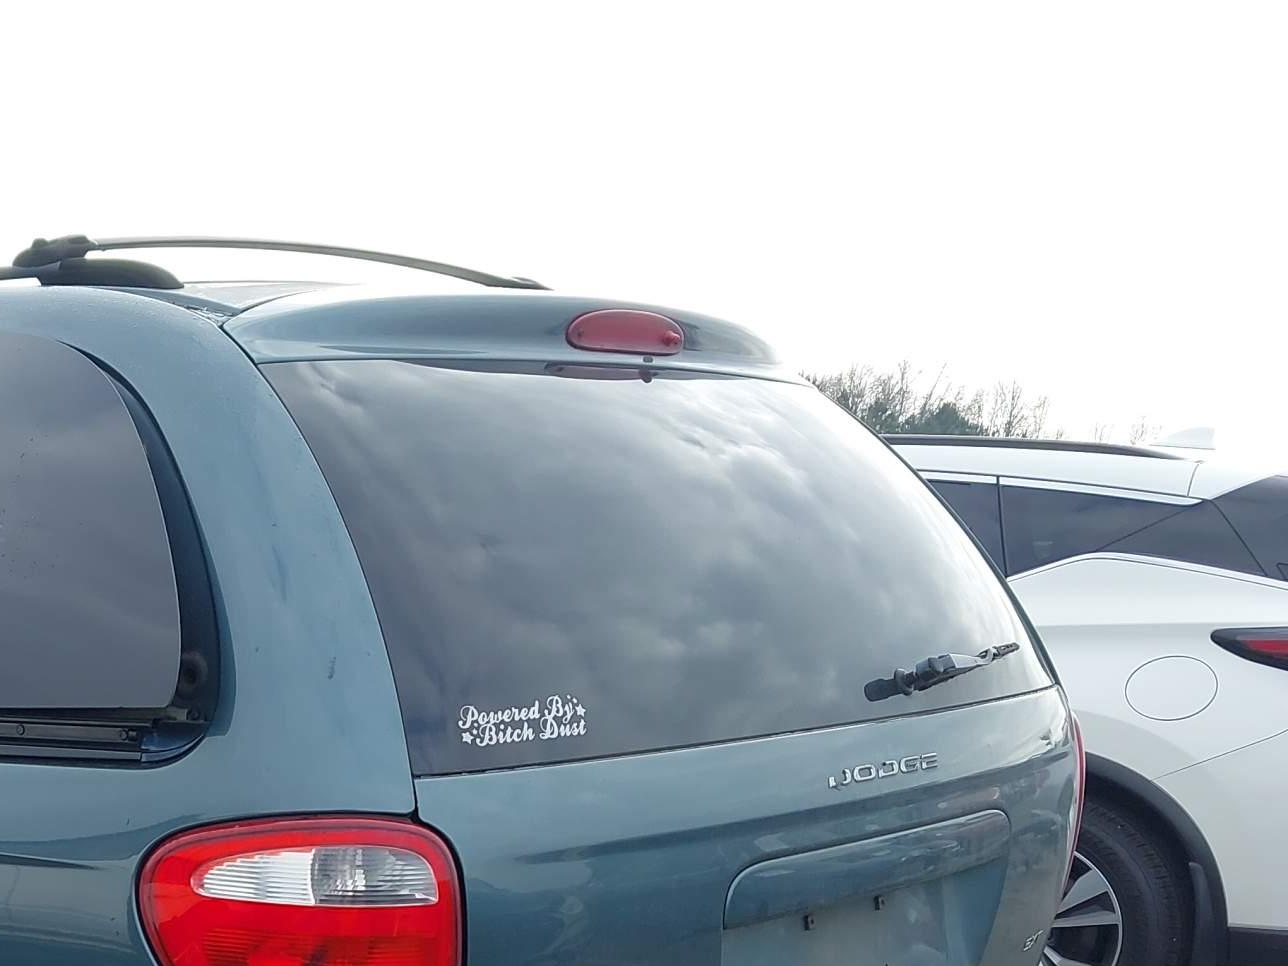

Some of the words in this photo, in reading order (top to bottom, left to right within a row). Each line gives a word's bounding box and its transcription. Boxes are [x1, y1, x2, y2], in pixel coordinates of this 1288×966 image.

[458, 700, 540, 729] Powered
[544, 694, 574, 723] By
[475, 722, 535, 746] Bitch
[539, 717, 587, 740] Dust
[828, 752, 938, 788] DODGE
